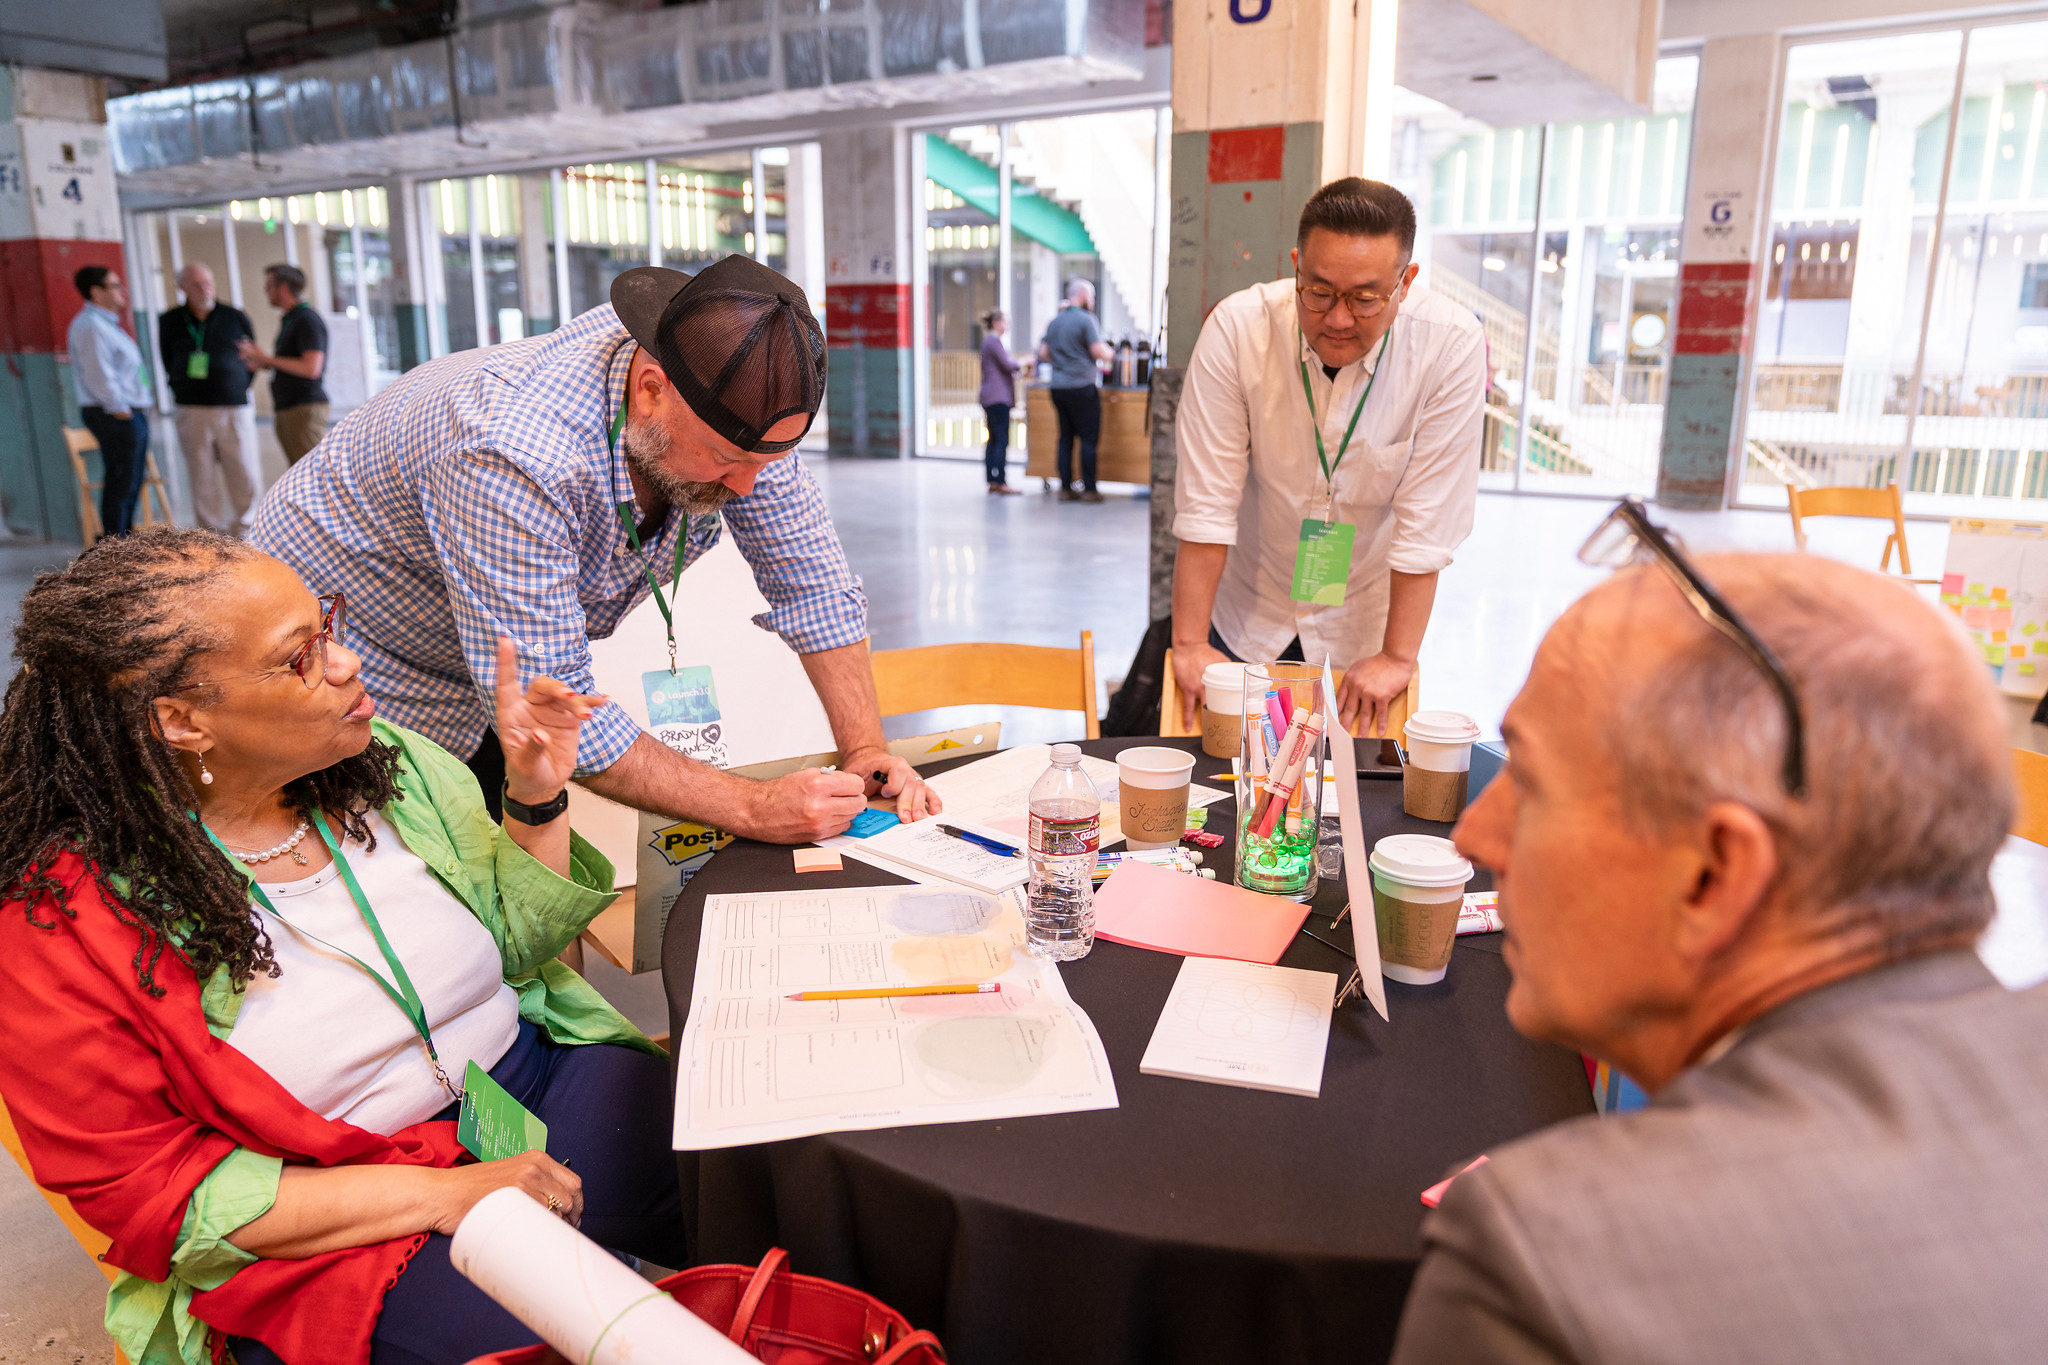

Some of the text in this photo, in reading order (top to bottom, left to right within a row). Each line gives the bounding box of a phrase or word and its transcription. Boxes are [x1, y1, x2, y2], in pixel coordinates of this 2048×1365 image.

[63, 178, 82, 204] 4
[1711, 200, 1731, 224] G
[659, 728, 700, 745] BRADY
